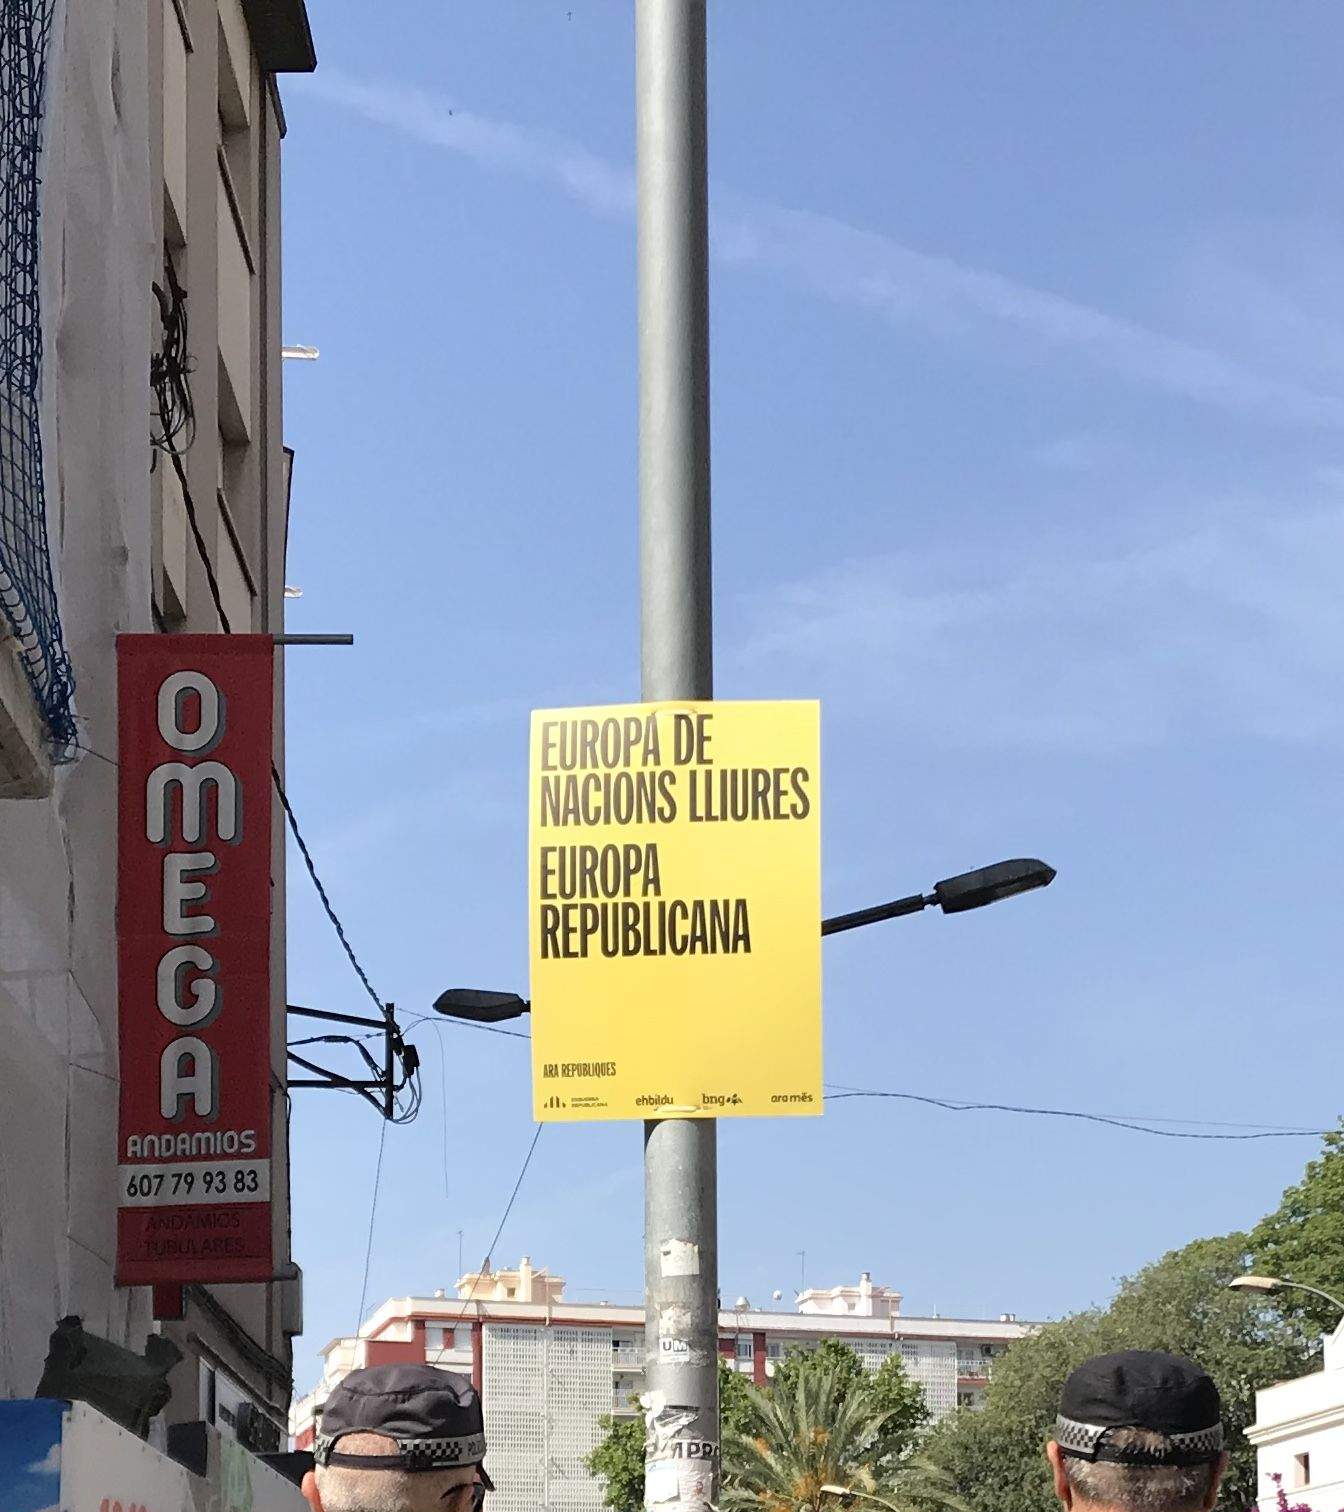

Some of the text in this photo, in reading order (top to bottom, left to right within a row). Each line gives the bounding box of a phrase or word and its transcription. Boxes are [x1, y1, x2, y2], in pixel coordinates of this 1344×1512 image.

[541, 713, 713, 772] EUROPA DE
[540, 766, 810, 827] NACIONS LLIURES
[146, 670, 244, 1120] OMEGA
[540, 843, 661, 900] EUROPA
[541, 898, 751, 959] REPUBLICANA
[543, 1061, 616, 1078] ARA REPUBLIQUES
[126, 1129, 256, 1158] ANDAMIOS
[126, 1168, 259, 1197] 607 79 93 83
